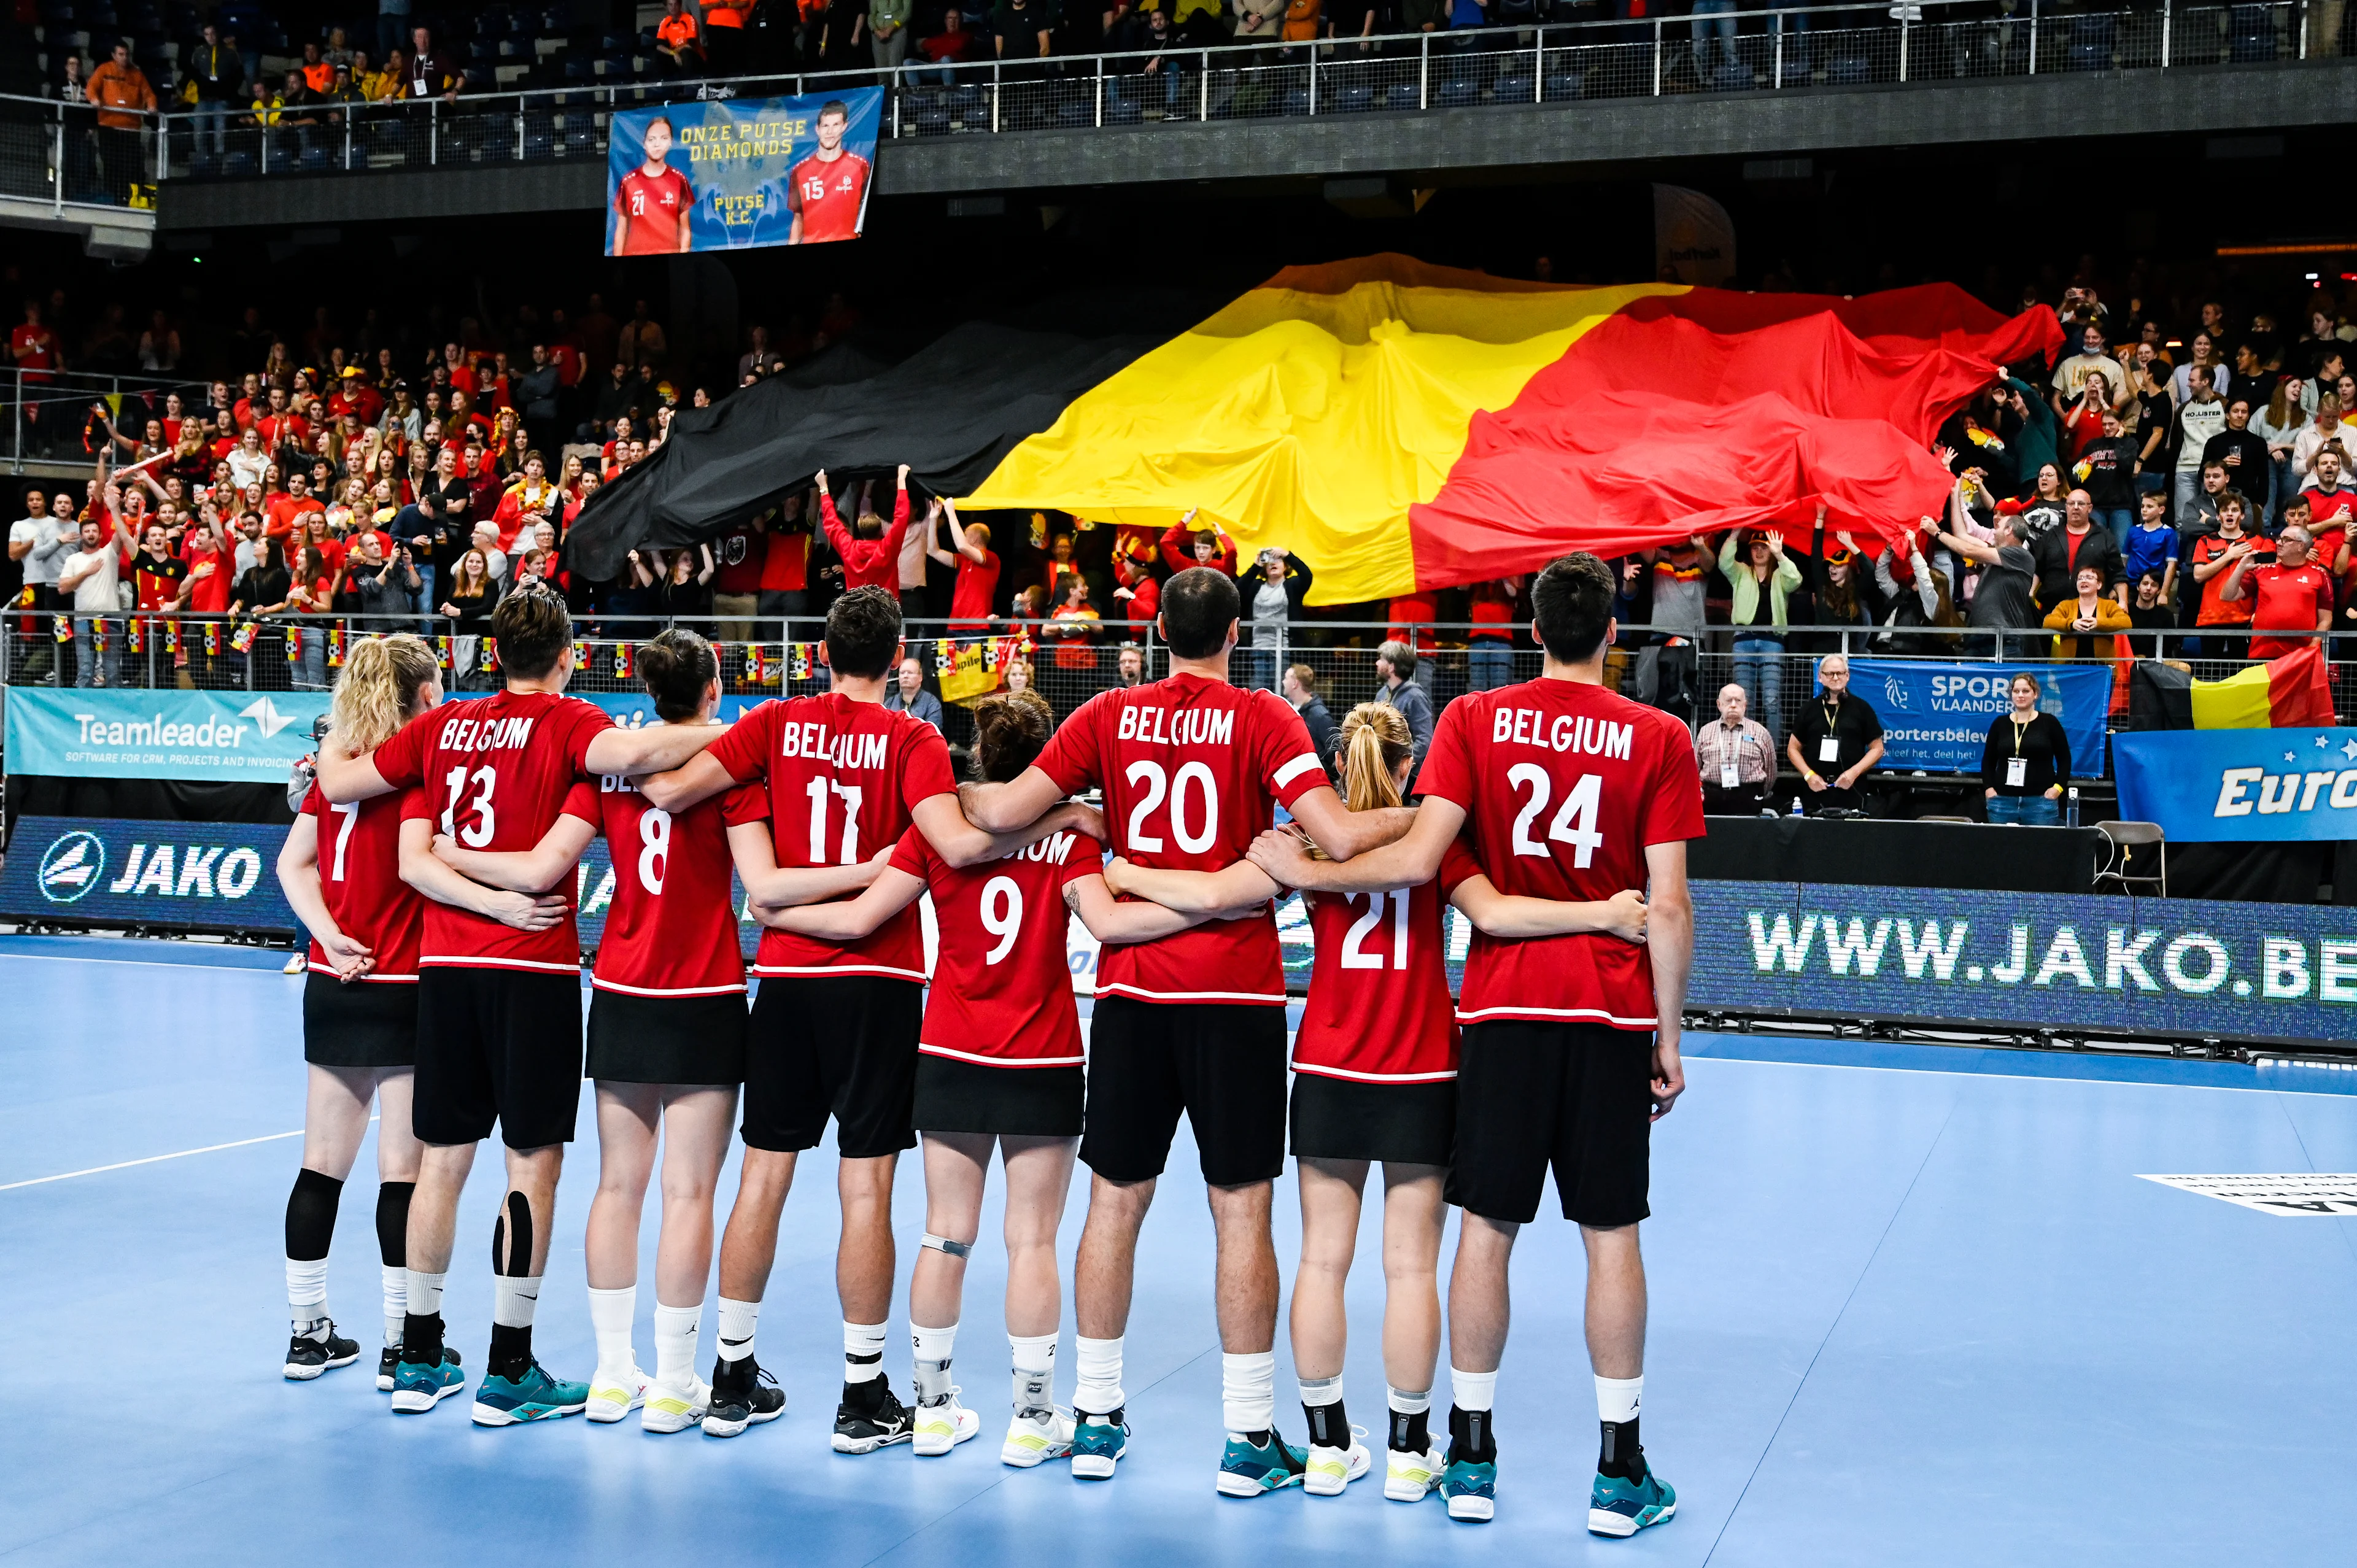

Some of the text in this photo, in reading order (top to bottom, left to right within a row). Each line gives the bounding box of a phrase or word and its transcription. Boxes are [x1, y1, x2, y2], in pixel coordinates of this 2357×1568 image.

[681, 120, 807, 144] ONZE PUTSE
[691, 139, 793, 161] DIAMONDS
[632, 195, 644, 215] 21
[714, 195, 765, 211] PUTSE
[802, 180, 824, 201] 15
[726, 211, 753, 225] K.C.
[957, 657, 980, 671] pile
[1931, 697, 2016, 714] VLAANDER
[1932, 676, 2009, 698] SPOR
[75, 713, 247, 747] Teamleader
[1118, 705, 1234, 746] BELGIUM
[1493, 708, 1633, 761] BELGIUM
[1882, 728, 1987, 744] portersbelev
[65, 752, 118, 763] SOFTWARE
[121, 754, 140, 763] FOR
[142, 754, 166, 765] CRM,
[169, 755, 220, 765] PROJECTS
[222, 756, 244, 767] AND
[783, 722, 888, 770] BELGIUM
[1933, 750, 1954, 759] deel
[1957, 751, 1976, 759] het!
[441, 765, 496, 848] 13
[807, 775, 862, 865] 17
[1126, 760, 1218, 854] 20
[1507, 763, 1603, 868] 24
[331, 802, 359, 881] 7
[639, 808, 671, 895] 8
[110, 844, 261, 898] JAKO
[980, 876, 1023, 965] 9
[1341, 892, 1410, 970] 21
[1747, 911, 2357, 1002] WWW.JAKO.BE
